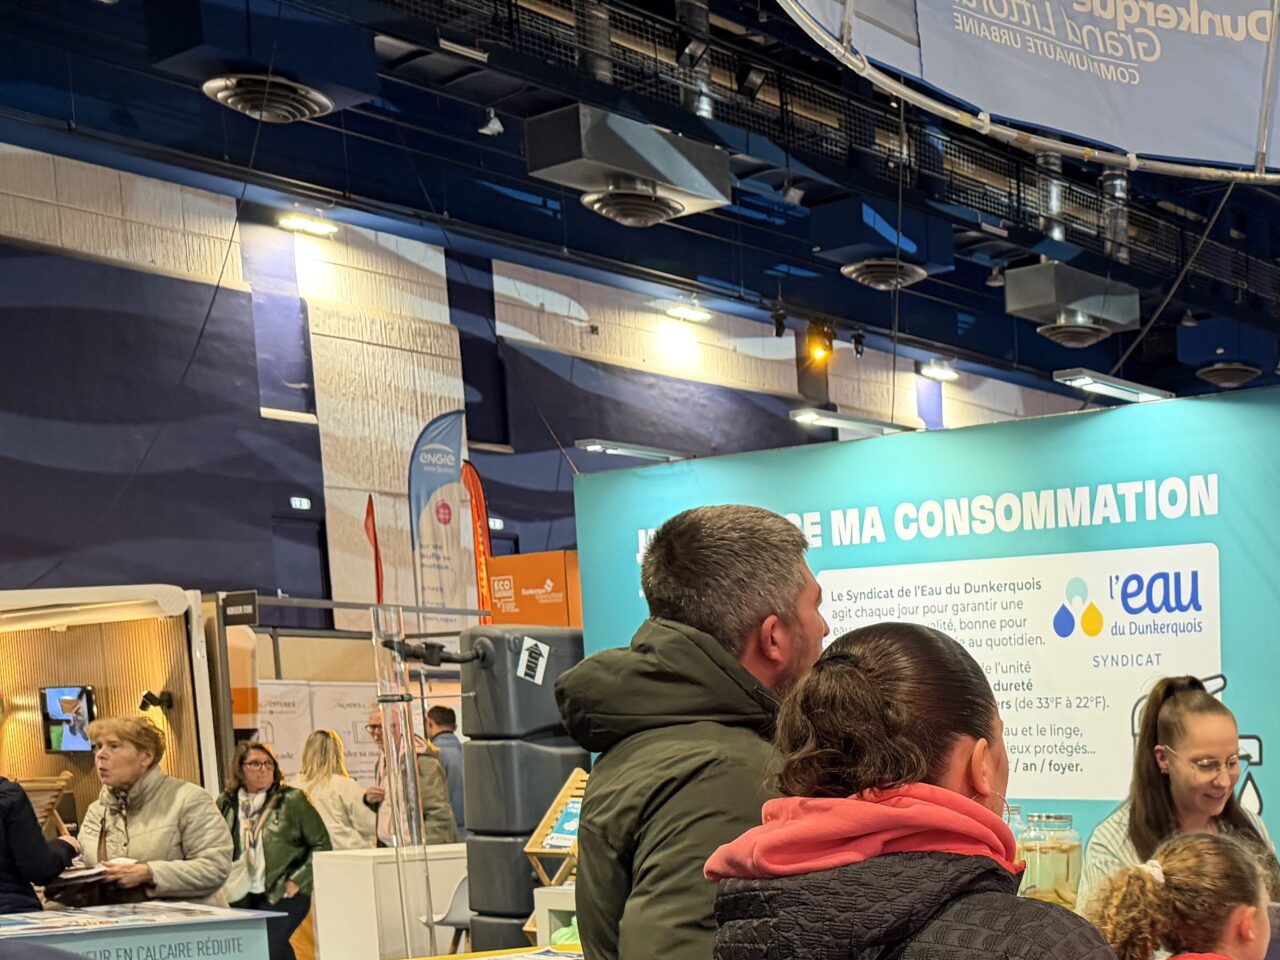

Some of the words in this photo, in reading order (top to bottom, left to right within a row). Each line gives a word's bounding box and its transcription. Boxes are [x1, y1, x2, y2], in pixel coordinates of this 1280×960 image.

[830, 506, 886, 547] MA
[894, 473, 1218, 541] CONSOMMATION
[831, 590, 844, 602] Le
[846, 587, 893, 604] Syndicat
[897, 586, 912, 599] de
[914, 585, 942, 598] l'Eau
[945, 583, 960, 595] du
[964, 577, 1042, 594] Dunkerquois
[1109, 570, 1203, 615] l'eau
[831, 606, 852, 622] agit
[854, 604, 896, 620] chaque
[897, 603, 919, 618] jour
[922, 603, 949, 618] pour
[951, 598, 998, 615] garantir
[1000, 600, 1024, 611] une
[959, 618, 997, 631] bonne
[1000, 617, 1027, 633] pour
[1111, 621, 1125, 636] du
[1129, 617, 1203, 637] Dunkerquois
[968, 637, 983, 648] au
[986, 635, 1046, 650] quotidien.
[995, 661, 1032, 674] l'unité
[1092, 653, 1162, 668] SYNDICAT
[993, 679, 1033, 692] dureté
[1015, 697, 1033, 712] (de
[1065, 697, 1072, 709] à
[1021, 725, 1033, 737] et
[1036, 724, 1047, 737] le
[1050, 723, 1083, 739] linge,
[1007, 742, 1031, 755] ieux
[1022, 762, 1037, 772] an
[1049, 760, 1084, 775] foyer.
[197, 937, 244, 957] RÉDUITE
